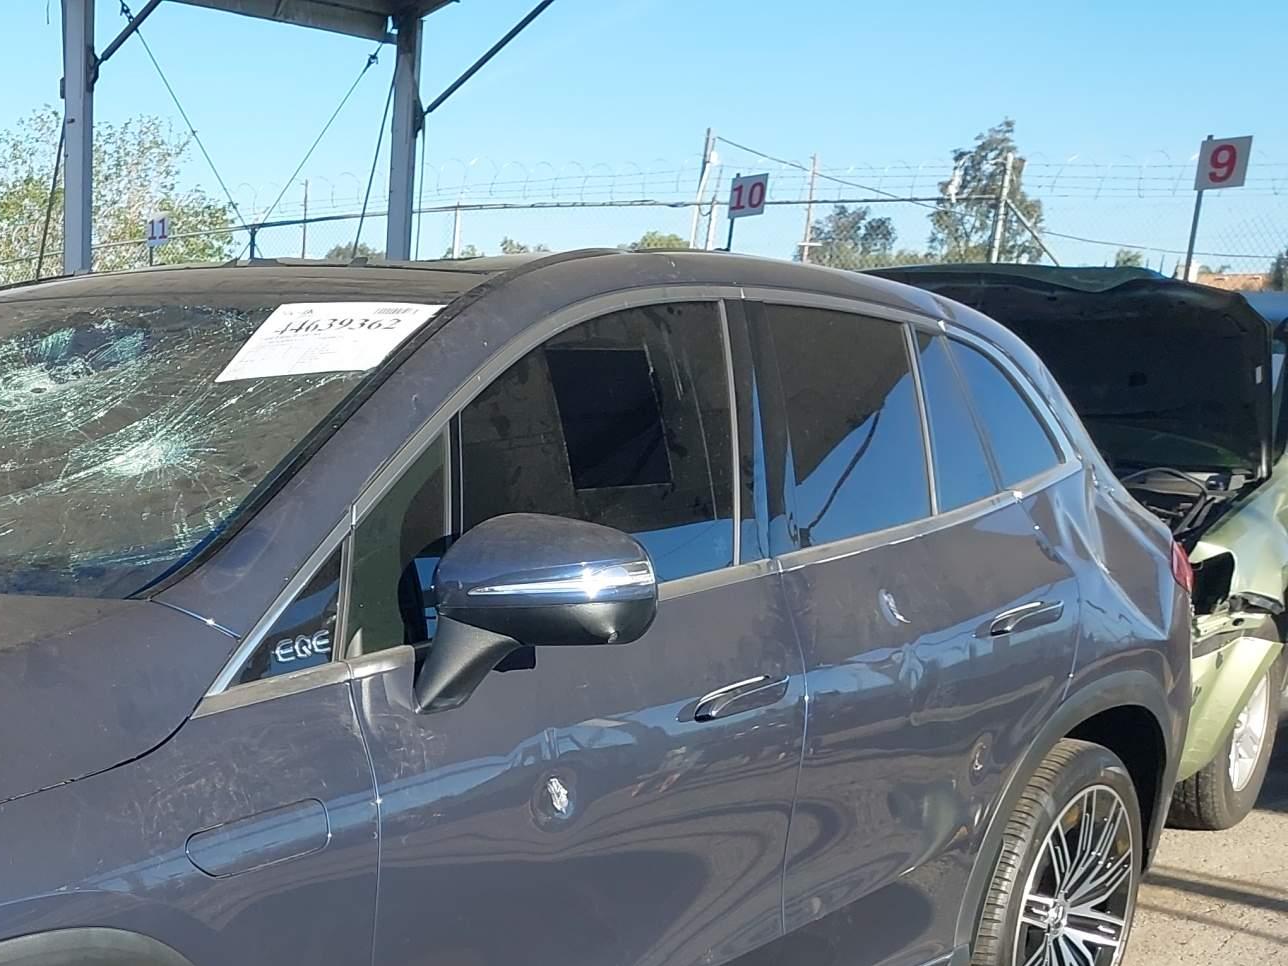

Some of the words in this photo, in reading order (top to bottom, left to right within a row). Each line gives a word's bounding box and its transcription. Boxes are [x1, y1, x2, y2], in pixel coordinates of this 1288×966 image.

[1208, 144, 1237, 184] 9
[730, 182, 765, 210] 10
[148, 218, 167, 240] 11
[273, 318, 402, 335] 44639362
[275, 629, 331, 663] EQE
